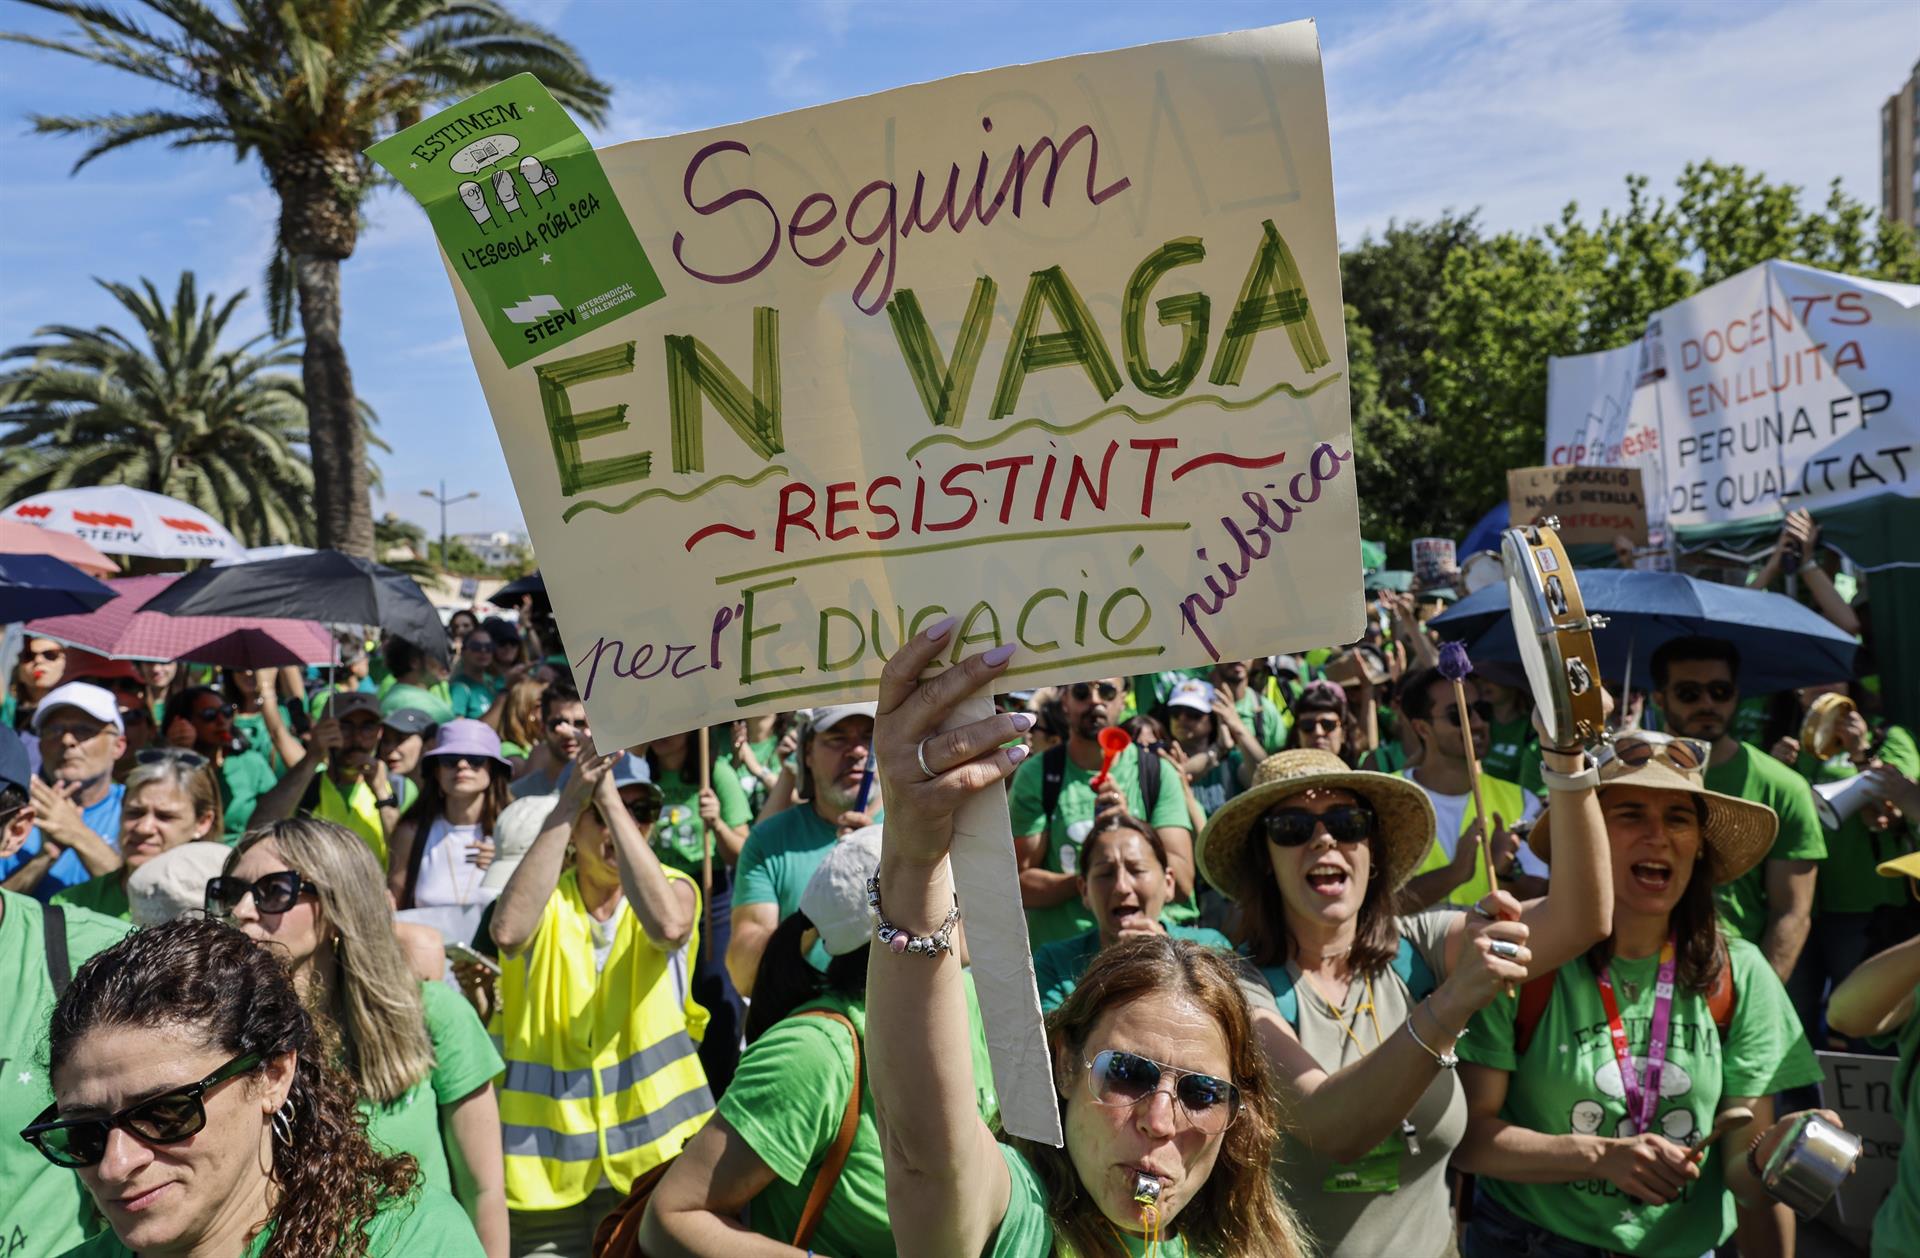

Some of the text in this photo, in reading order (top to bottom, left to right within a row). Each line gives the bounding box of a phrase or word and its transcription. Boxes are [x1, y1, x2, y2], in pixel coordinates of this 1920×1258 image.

[411, 102, 523, 163] ESTIMEM
[672, 116, 1132, 316] Seguim
[461, 231, 539, 272] L'ESCOLA
[524, 309, 578, 345] STEPV
[576, 282, 634, 313] INTERSINDICAL
[589, 289, 637, 317] VALENCIANA
[536, 219, 1332, 497] EN VAGA
[1680, 290, 1874, 373] DOCENTS
[1687, 339, 1867, 418] EN LLUITA
[1677, 387, 1893, 468] PER UNA FP
[1669, 444, 1914, 515] DE QUALITAT
[75, 527, 144, 544] STEPV
[176, 533, 227, 549] STEPV
[575, 637, 707, 701] per
[1179, 442, 1352, 662] pública
[1573, 1016, 1714, 1058] ESTIEM
